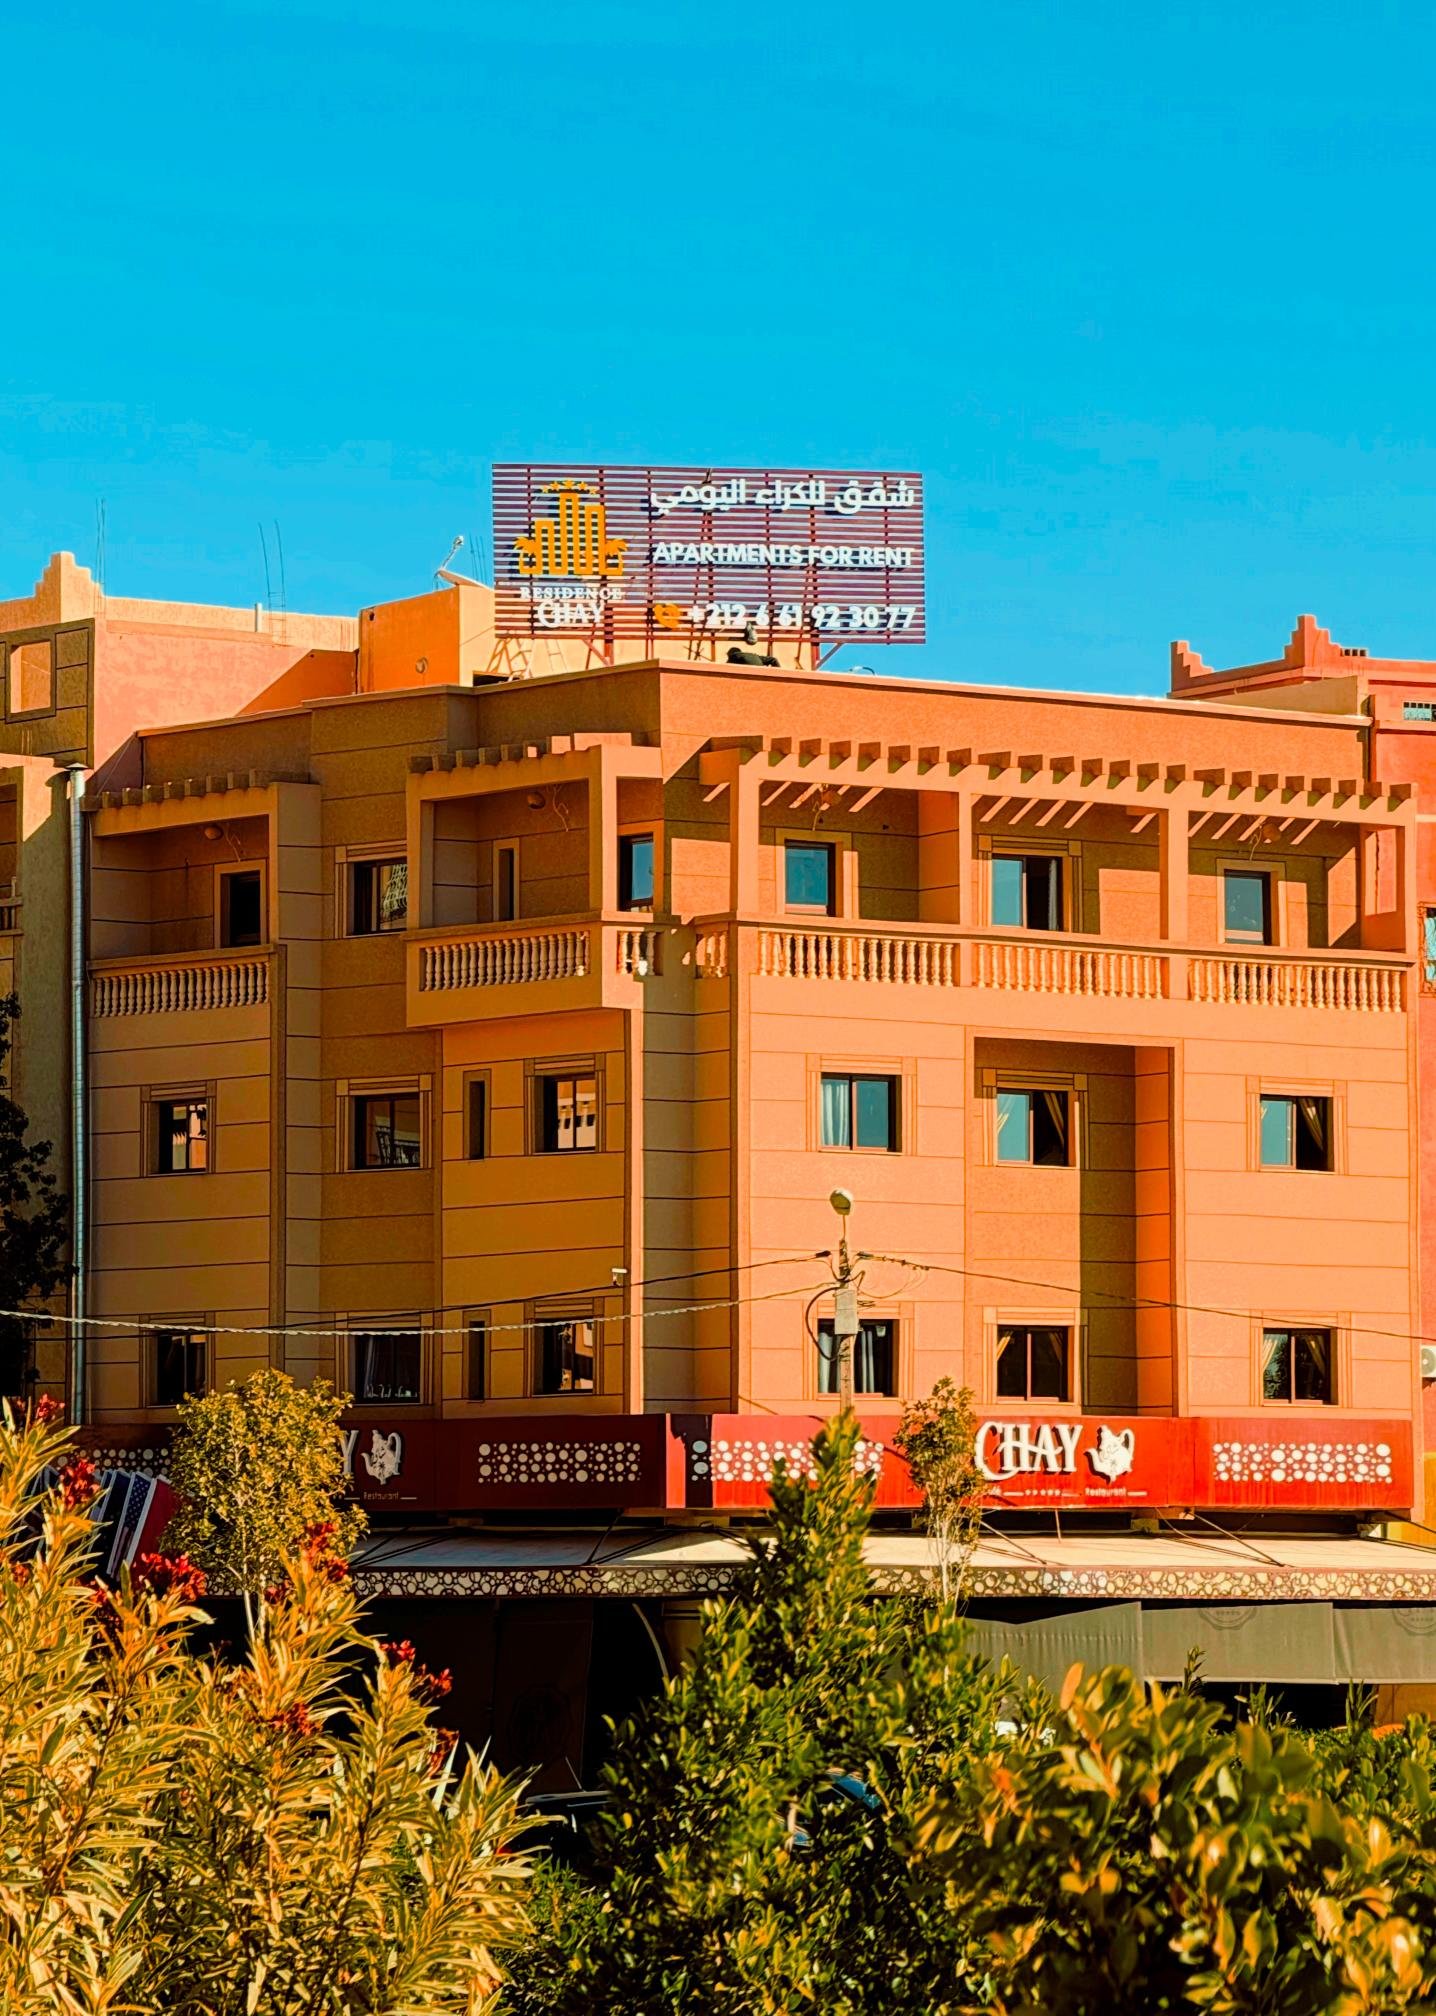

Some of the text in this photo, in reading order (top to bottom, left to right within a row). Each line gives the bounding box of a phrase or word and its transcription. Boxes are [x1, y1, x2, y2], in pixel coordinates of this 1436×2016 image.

[650, 478, 915, 515] شقق للكراء اليومي
[652, 541, 915, 567] APARTMENTS FOR RENT
[519, 586, 622, 600] RESIDENCE
[537, 599, 605, 628] CHAY
[689, 603, 917, 629] +212 6 61 92 30 77
[974, 1421, 1084, 1481] CHAY
[363, 1491, 399, 1501] Restaurant
[1085, 1487, 1127, 1497] Restaurant
